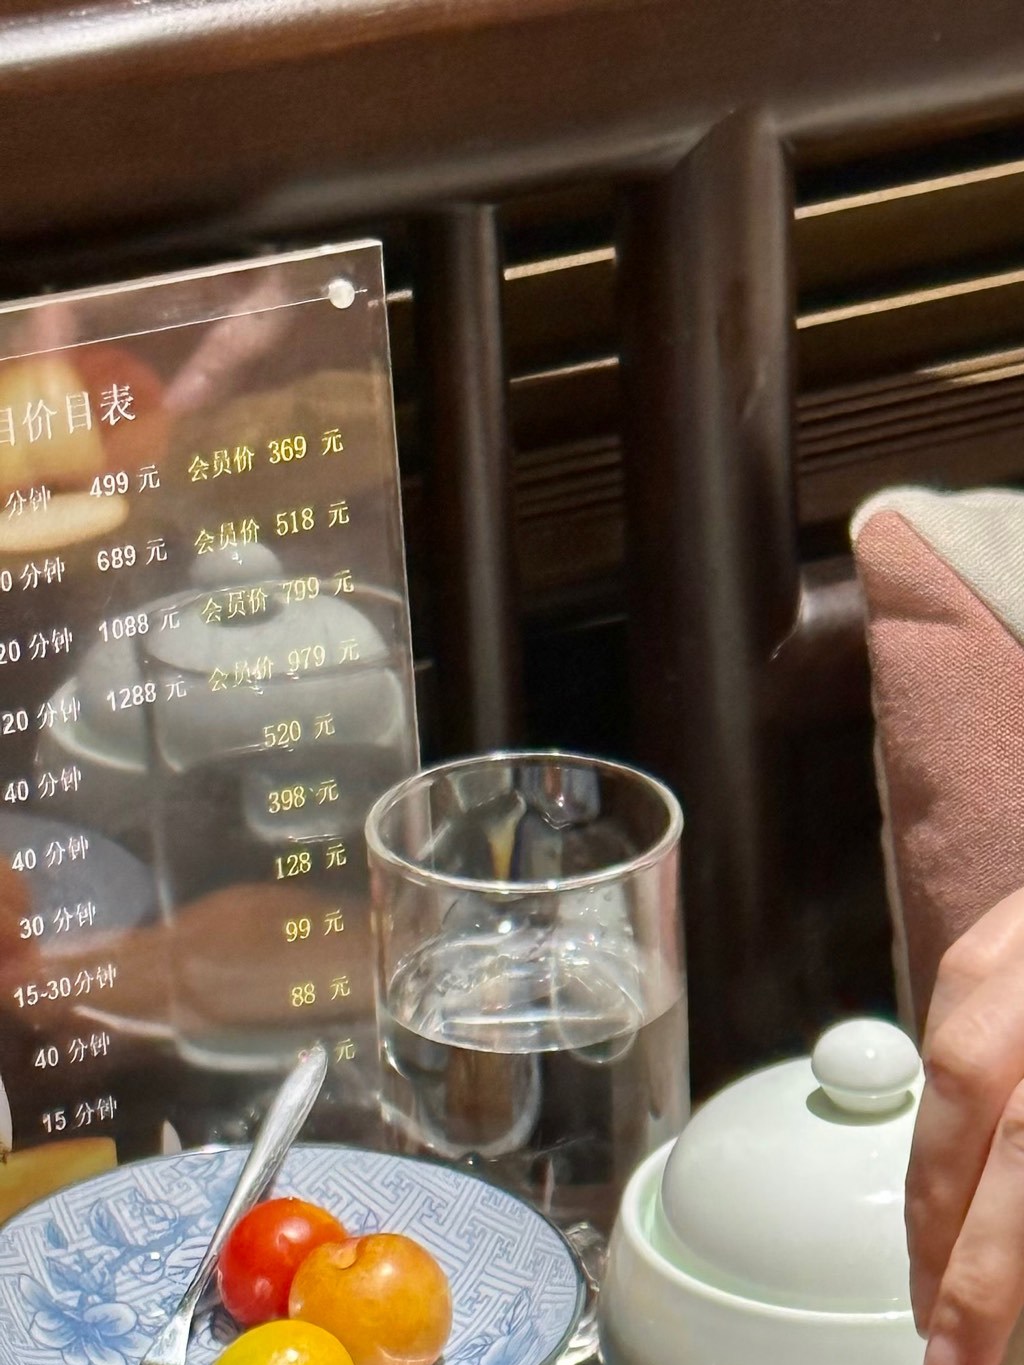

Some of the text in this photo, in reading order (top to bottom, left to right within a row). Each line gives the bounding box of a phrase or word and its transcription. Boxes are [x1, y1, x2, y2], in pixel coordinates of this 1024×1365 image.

[5, 428, 344, 520] 分钟 499 元 会员价 369 元
[20, 556, 65, 591] 分钟
[97, 544, 136, 572] 689
[146, 537, 168, 565] 元
[194, 518, 260, 555] 会员价
[276, 507, 314, 536] 518
[328, 500, 350, 527] 元
[29, 627, 73, 661] 分钟
[98, 613, 149, 642] 1088
[159, 605, 181, 631] 元
[201, 590, 268, 625] 会员价
[281, 576, 320, 604] 799
[333, 569, 355, 596] 元
[2, 638, 360, 735] 20 分钟 1288 元 会员价 979 元
[4, 713, 336, 803] 40 分钟 520 元
[11, 779, 339, 872] 40 分钟 398 元
[19, 843, 347, 940] 30 分钟 128 元
[285, 917, 312, 943] 99
[323, 909, 345, 935] 元
[34, 975, 351, 1070] 40 分钟 88 元
[42, 1109, 67, 1134] 15
[75, 1095, 118, 1127] 分钟
[334, 1038, 356, 1063] 元
